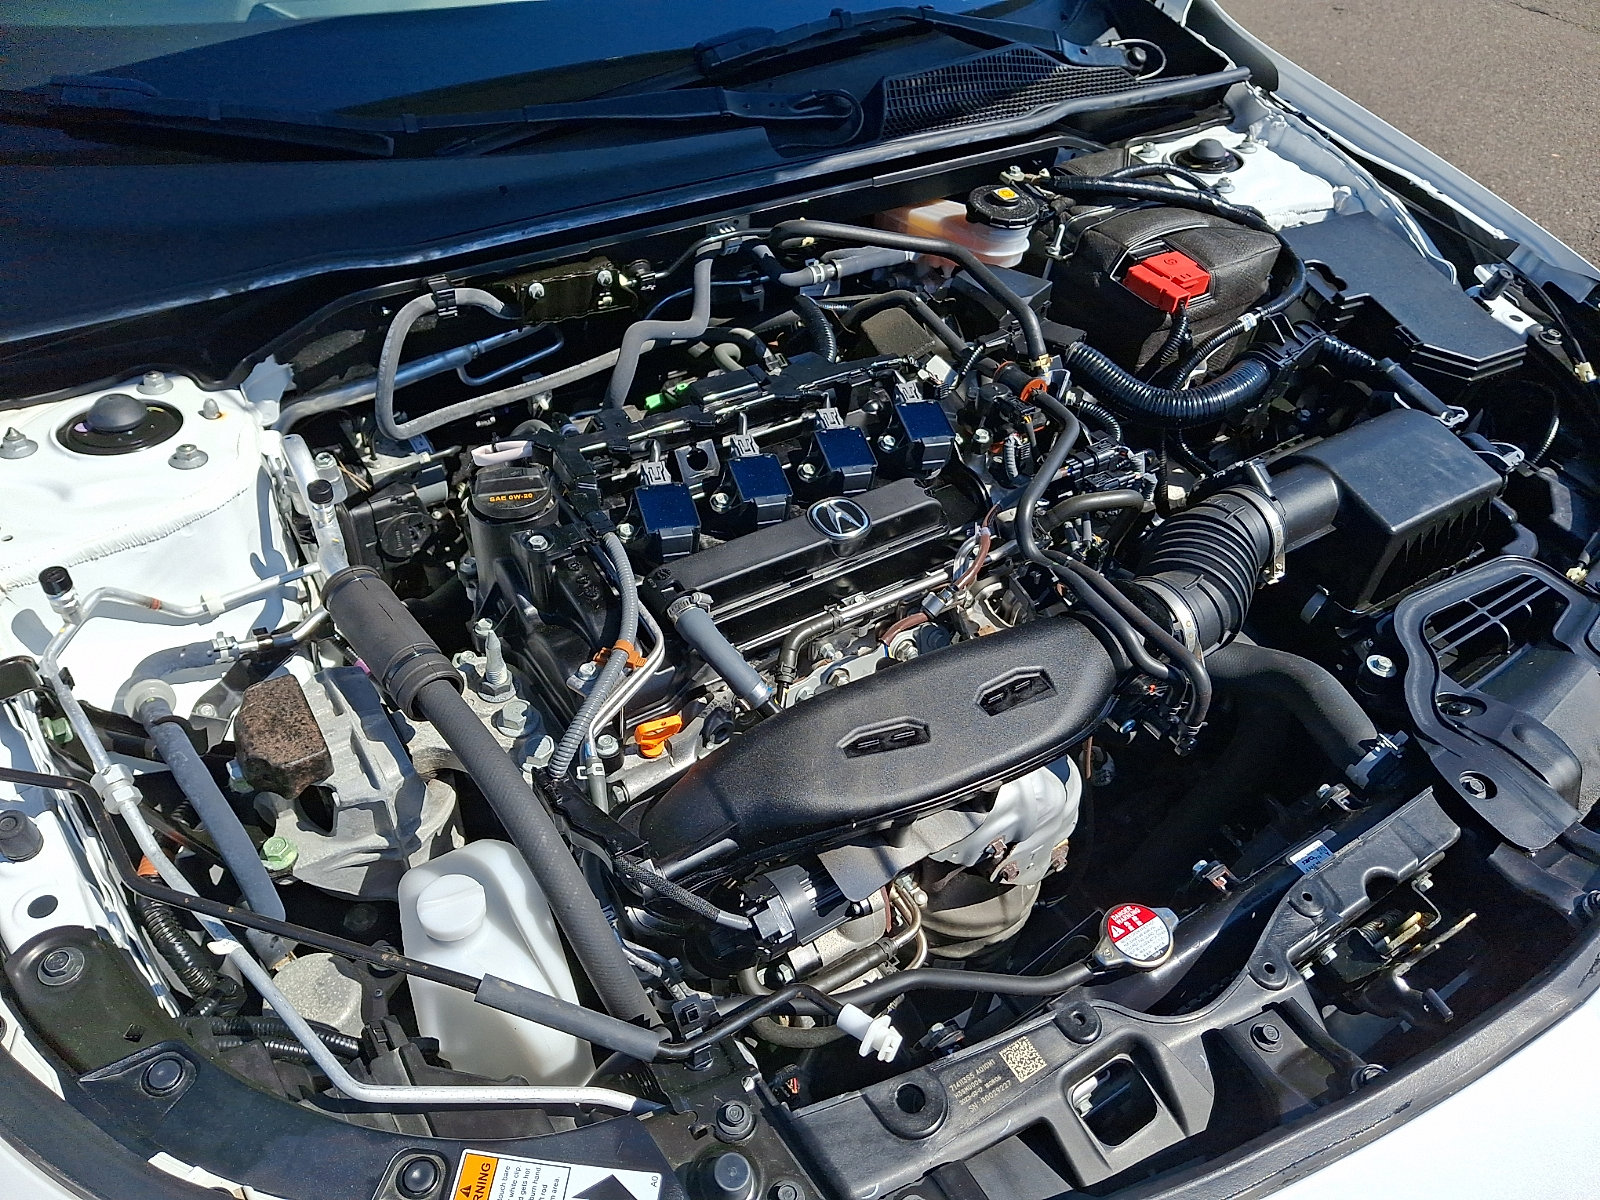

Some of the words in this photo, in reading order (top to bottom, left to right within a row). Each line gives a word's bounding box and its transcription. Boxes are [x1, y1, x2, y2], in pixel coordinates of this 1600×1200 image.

[489, 495, 507, 503] SAE
[508, 493, 534, 501] 0W-20
[1115, 907, 1141, 926] WARNING
[502, 1165, 511, 1181] bare
[523, 1168, 531, 1179] hot
[509, 1179, 518, 1198] white
[520, 1180, 528, 1196] gets
